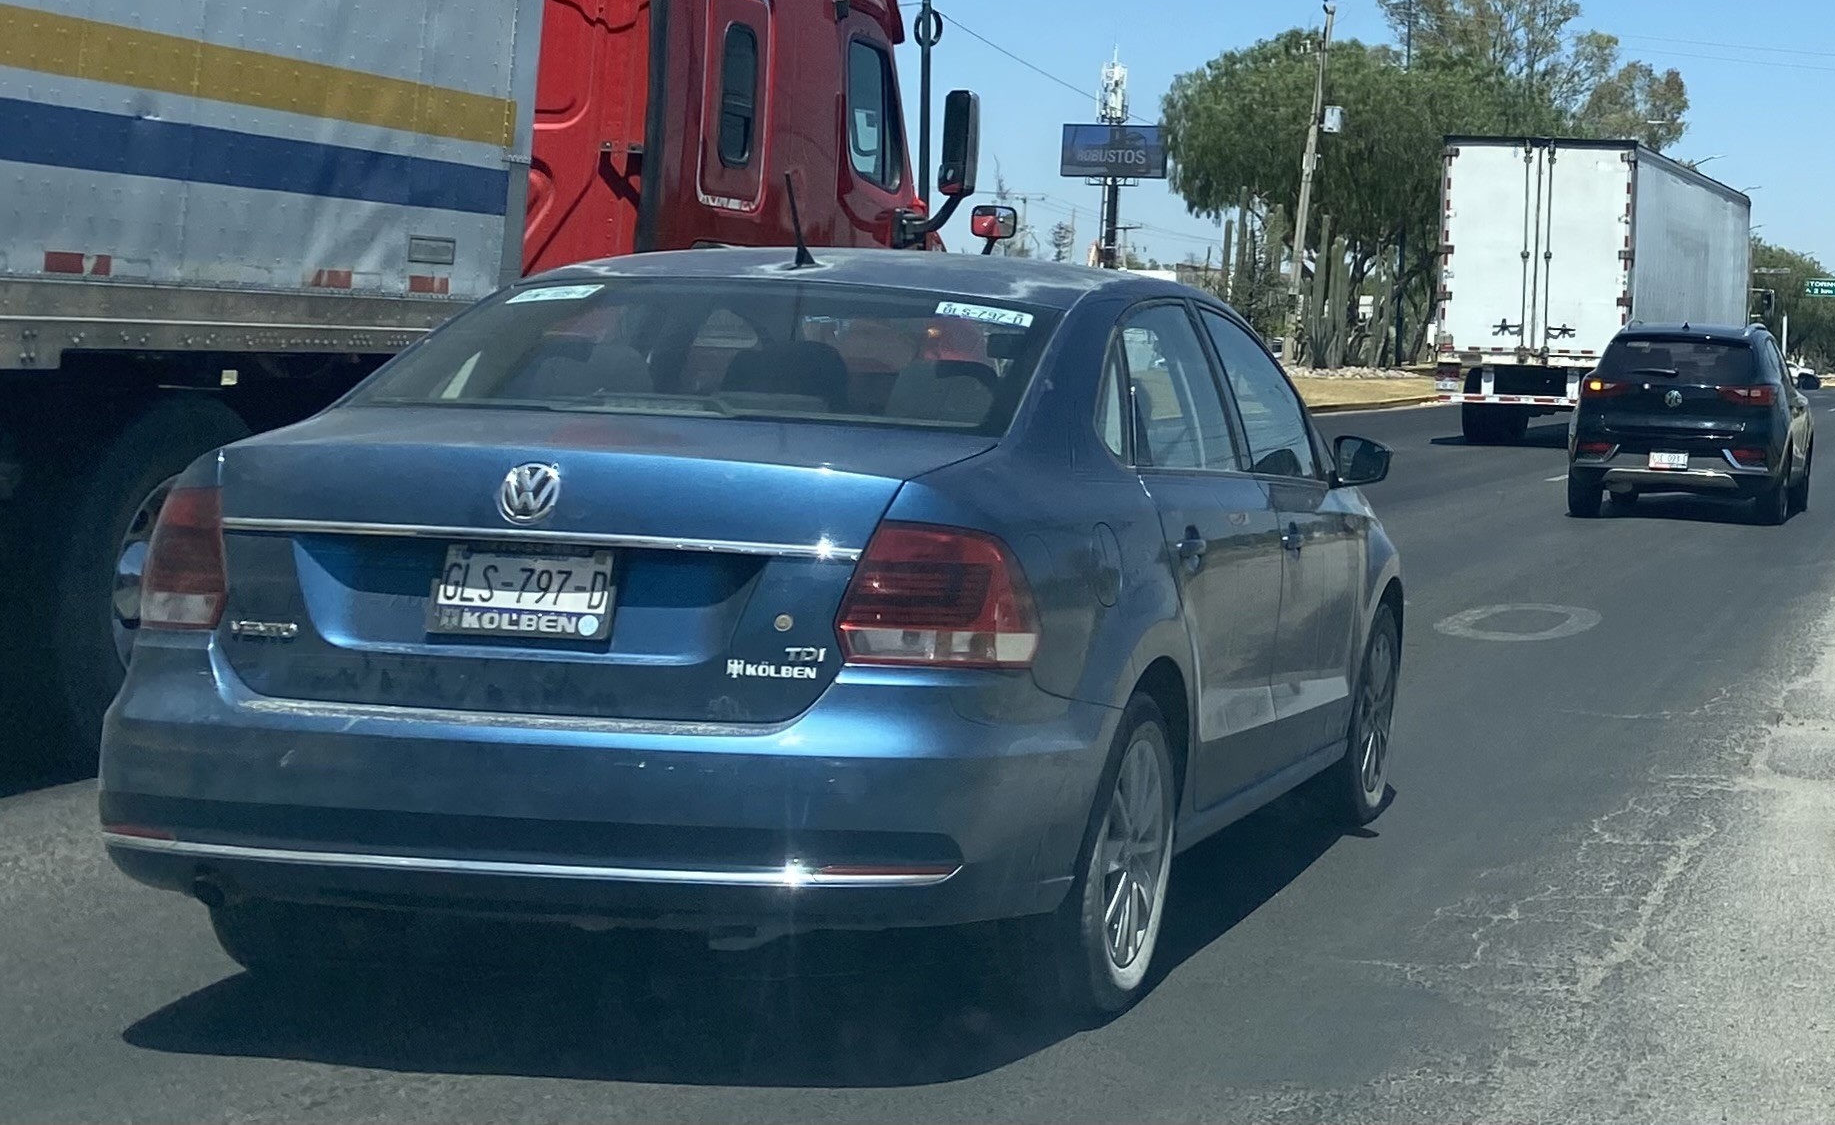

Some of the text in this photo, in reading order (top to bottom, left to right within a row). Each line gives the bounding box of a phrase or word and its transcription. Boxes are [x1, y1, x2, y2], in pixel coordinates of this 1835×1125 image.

[1076, 148, 1146, 165] ROBUSTOS
[442, 562, 608, 610] GLS-797-D
[784, 646, 827, 662] TDI
